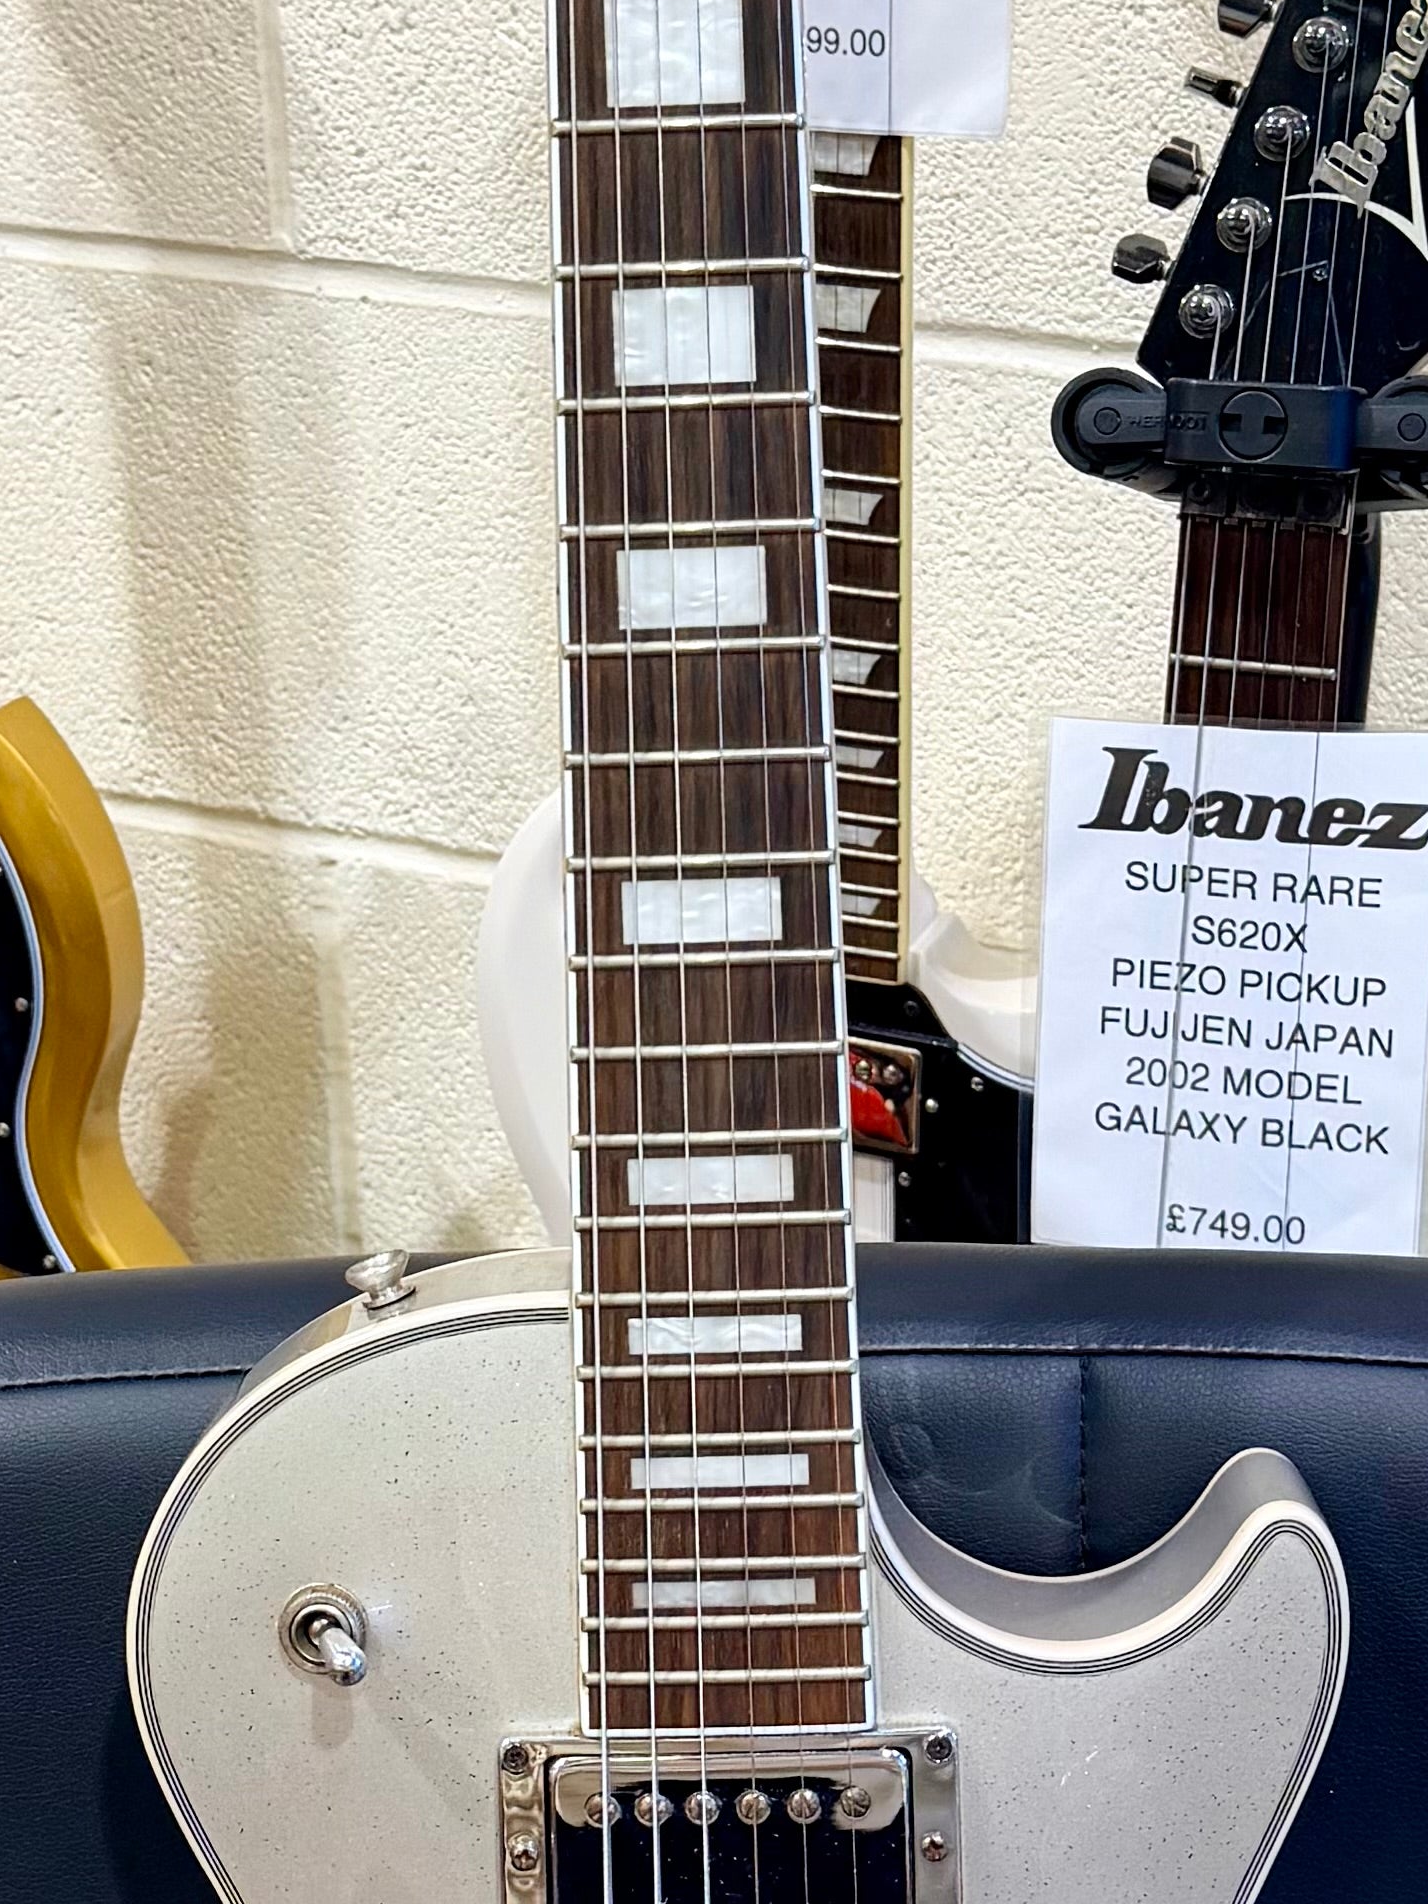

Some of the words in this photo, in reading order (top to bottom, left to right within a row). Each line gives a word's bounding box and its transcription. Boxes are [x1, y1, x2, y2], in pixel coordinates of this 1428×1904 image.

[806, 27, 886, 58] 99.00
[1124, 860, 1259, 901] SUPER
[1271, 872, 1383, 908] RARE
[1190, 915, 1308, 954] S620X
[1110, 958, 1227, 996] PIEZO
[1239, 968, 1387, 1008] PICKUP
[1264, 1020, 1394, 1059] JAPAN
[1124, 1056, 1211, 1093] 2002
[1222, 1064, 1364, 1105] MODEL
[1095, 1102, 1248, 1145] GALAXY
[1260, 1118, 1391, 1155] BLACK
[1165, 1203, 1306, 1245] £749.00
